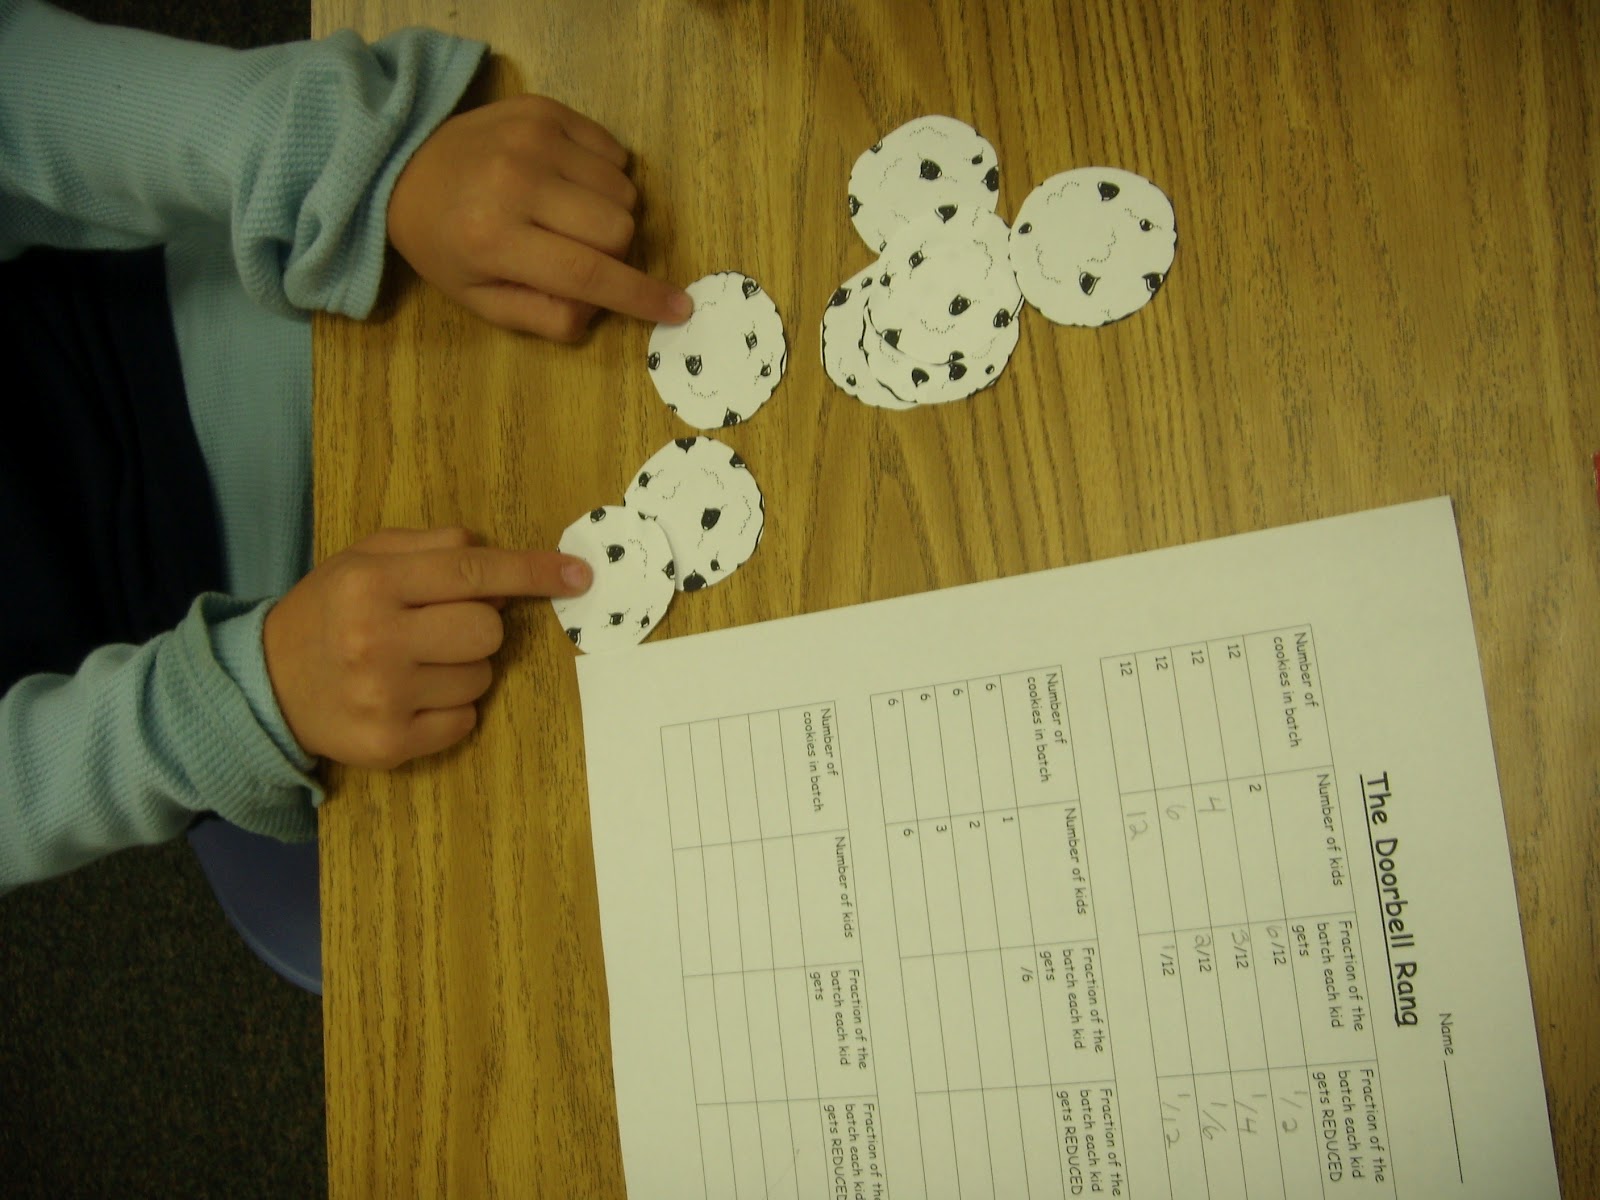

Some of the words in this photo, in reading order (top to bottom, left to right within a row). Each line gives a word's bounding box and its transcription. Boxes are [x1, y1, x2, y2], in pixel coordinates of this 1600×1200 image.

[1155, 656, 1168, 671] 12
[1191, 650, 1204, 665] 12
[1228, 644, 1241, 659] 12
[1274, 636, 1290, 686] cookies
[1120, 661, 1132, 677] 12
[1294, 632, 1312, 687] Number
[1305, 692, 1319, 707] of
[920, 693, 931, 702] 6
[953, 688, 963, 696] 6
[986, 683, 997, 691] 6
[1027, 676, 1042, 724] cookies
[1283, 691, 1292, 703] in
[1046, 672, 1061, 725] Number
[1055, 731, 1067, 744] of
[803, 711, 815, 757] cookies
[821, 708, 833, 758] Number
[827, 762, 838, 776] of
[1035, 729, 1043, 740] in
[1285, 707, 1299, 748] batch
[809, 761, 817, 773] in
[1036, 745, 1049, 783] batch
[811, 775, 824, 812] batch
[1249, 784, 1261, 792] 2
[1317, 773, 1335, 831] Number
[1367, 772, 1392, 825] The
[1199, 796, 1227, 813] 4
[903, 829, 914, 837] 6
[969, 821, 980, 829] 2
[1065, 808, 1079, 863] Number
[1327, 838, 1341, 852] of
[835, 836, 848, 889] Number
[1073, 868, 1085, 882] of
[1329, 857, 1342, 886] kids
[841, 893, 852, 907] of
[1074, 887, 1087, 915] kids
[1375, 837, 1414, 949] Doorbell
[843, 912, 853, 939] kids
[1292, 925, 1309, 956] gets
[1317, 922, 1331, 964] batch
[1339, 920, 1356, 981] Fraction
[1021, 966, 1033, 982] /6
[1040, 951, 1055, 981] gets
[1063, 950, 1076, 988] batch
[1083, 947, 1097, 1006] Fraction
[809, 972, 823, 1000] gets
[831, 970, 842, 1007] batch
[849, 968, 862, 1025] Fraction
[1324, 968, 1337, 1002] each
[1350, 986, 1363, 1003] of
[1394, 962, 1418, 1027] Rang
[1069, 993, 1080, 1024] each
[1090, 1009, 1104, 1024] of
[1329, 1006, 1342, 1028] kid
[1352, 1006, 1364, 1032] the
[835, 1012, 846, 1041] each
[855, 1028, 867, 1042] of
[1072, 1029, 1084, 1049] kid
[1093, 1029, 1103, 1053] the
[1439, 1012, 1454, 1056] Name
[839, 1046, 850, 1066] kid
[857, 1046, 867, 1069] the
[1338, 1070, 1352, 1112] batch
[1360, 1069, 1376, 1132] Fraction
[824, 1105, 838, 1134] gets
[845, 1104, 857, 1141] batch
[1080, 1089, 1093, 1130] batch
[1100, 1088, 1114, 1148] Fraction
[863, 1104, 876, 1159] Fraction
[870, 1163, 882, 1178] of
[1313, 1072, 1330, 1104] gets
[1322, 1110, 1342, 1182] REDUCED
[1344, 1118, 1358, 1150] each
[1057, 1091, 1072, 1122] gets
[1065, 1126, 1083, 1195] REDUCED
[1085, 1134, 1097, 1166] each
[1370, 1137, 1382, 1150] of
[850, 1147, 860, 1177] each
[1108, 1152, 1121, 1168] of
[1350, 1154, 1362, 1178] kid
[1372, 1157, 1384, 1183] the
[1090, 1171, 1101, 1192] kid
[1111, 1173, 1121, 1197] the
